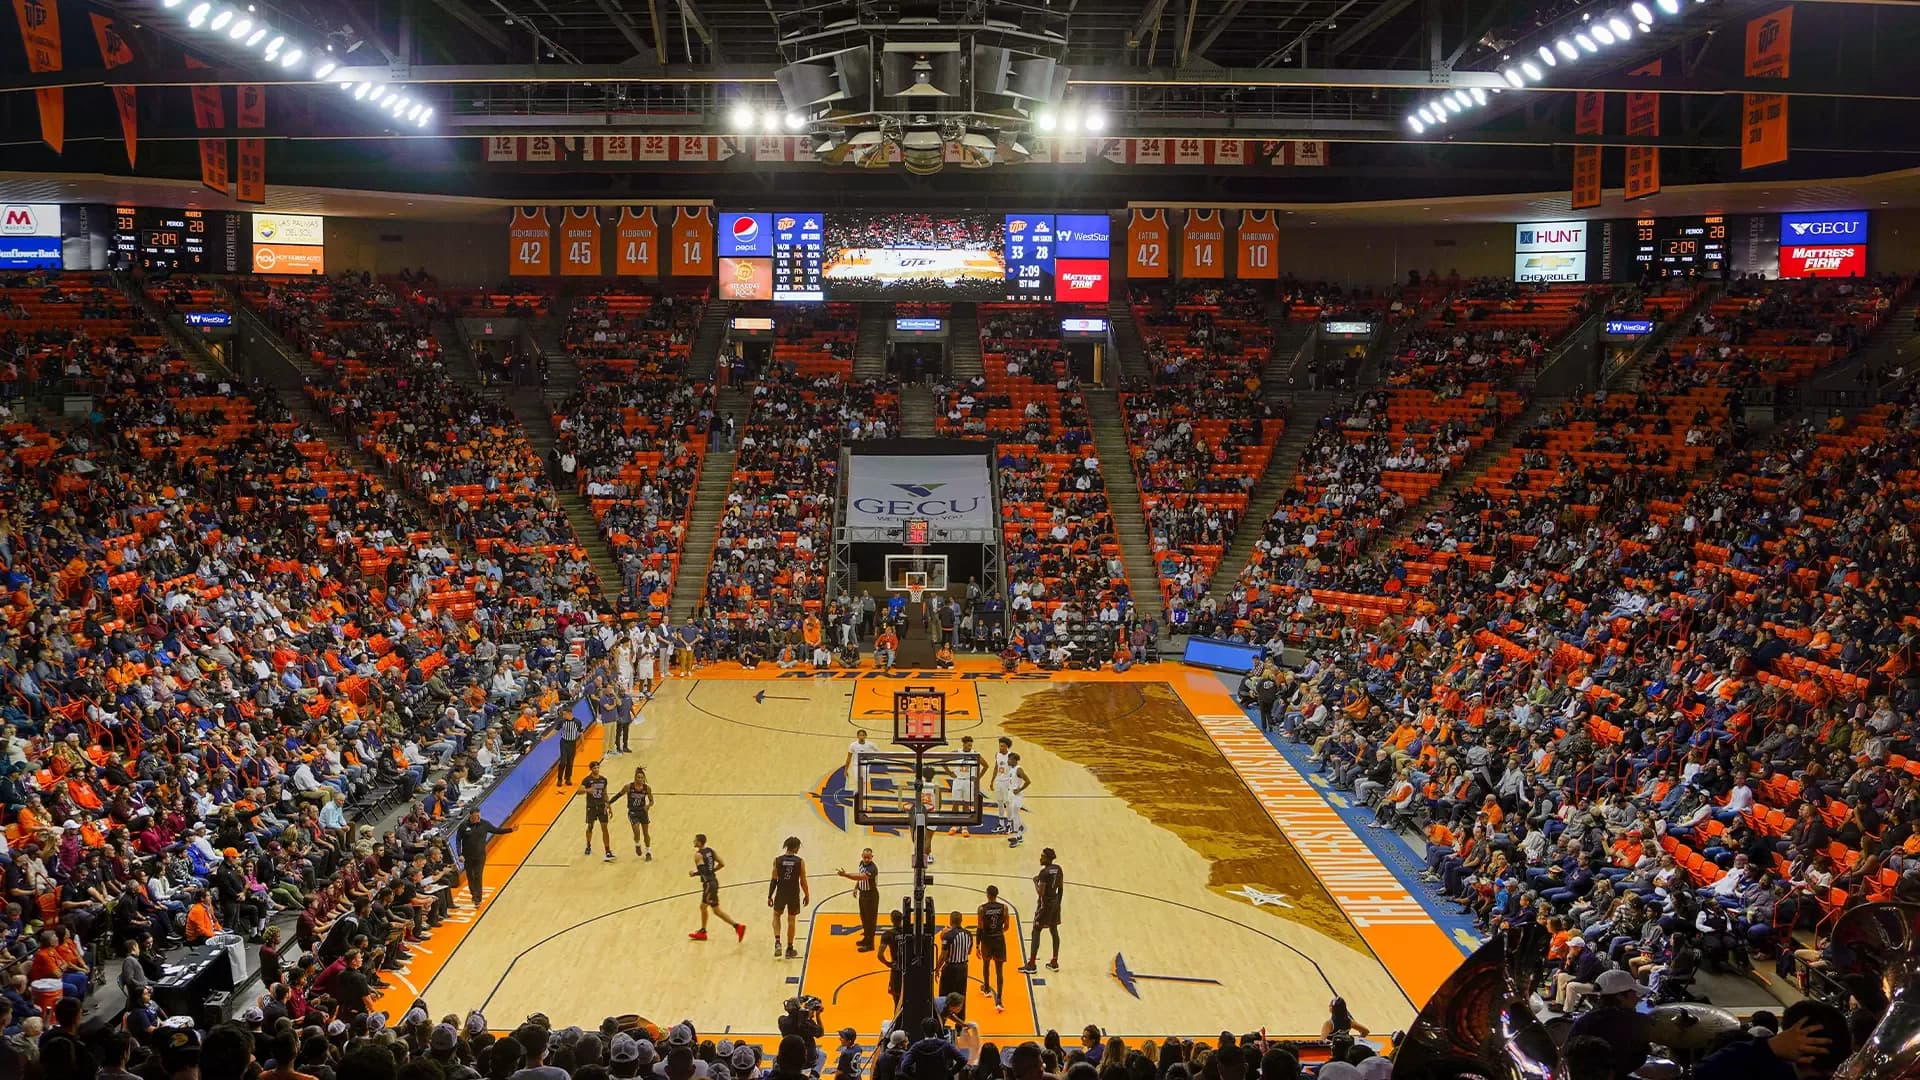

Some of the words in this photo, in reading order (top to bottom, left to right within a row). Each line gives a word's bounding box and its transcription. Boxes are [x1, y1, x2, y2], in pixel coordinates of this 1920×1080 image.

[496, 137, 510, 149] 12
[534, 137, 549, 149] 25
[610, 137, 625, 149] 23
[647, 137, 662, 149] 32
[686, 137, 702, 149] 24
[1142, 140, 1159, 151] 34
[1181, 140, 1198, 151] 44
[1222, 140, 1237, 152] 25
[119, 217, 133, 229] 33
[190, 221, 203, 232] 28
[1810, 222, 1857, 234] GECU
[1074, 233, 1109, 241] WestStar
[1188, 232, 1220, 240] ARCHIBALD
[1536, 230, 1582, 243] HUNT
[1640, 229, 1653, 240] 33
[1710, 226, 1724, 238] 28
[152, 233, 176, 245] 2:09
[520, 242, 540, 264] 42
[569, 242, 591, 264] 45
[626, 242, 648, 263] 44
[683, 242, 701, 264] 14
[1012, 246, 1023, 259] 33
[1036, 246, 1048, 259] 28
[1671, 241, 1695, 253] 2:09
[1792, 248, 1854, 258] MATTRESS
[1137, 244, 1159, 266] 42
[1195, 244, 1213, 266] 14
[1249, 245, 1268, 267] 10
[901, 259, 935, 267] UTEP
[1804, 258, 1842, 268] FIRM
[1019, 265, 1039, 277] 2:09
[853, 497, 978, 516] GECU
[776, 671, 1052, 680] MINERS
[1196, 714, 1261, 735] PASO
[1214, 737, 1270, 745] EL
[1221, 747, 1281, 757] AT
[1231, 759, 1313, 791] TEXAS
[1257, 793, 1327, 807] OF
[1269, 810, 1405, 891] UNIVERSITY
[1335, 895, 1437, 926] THE
